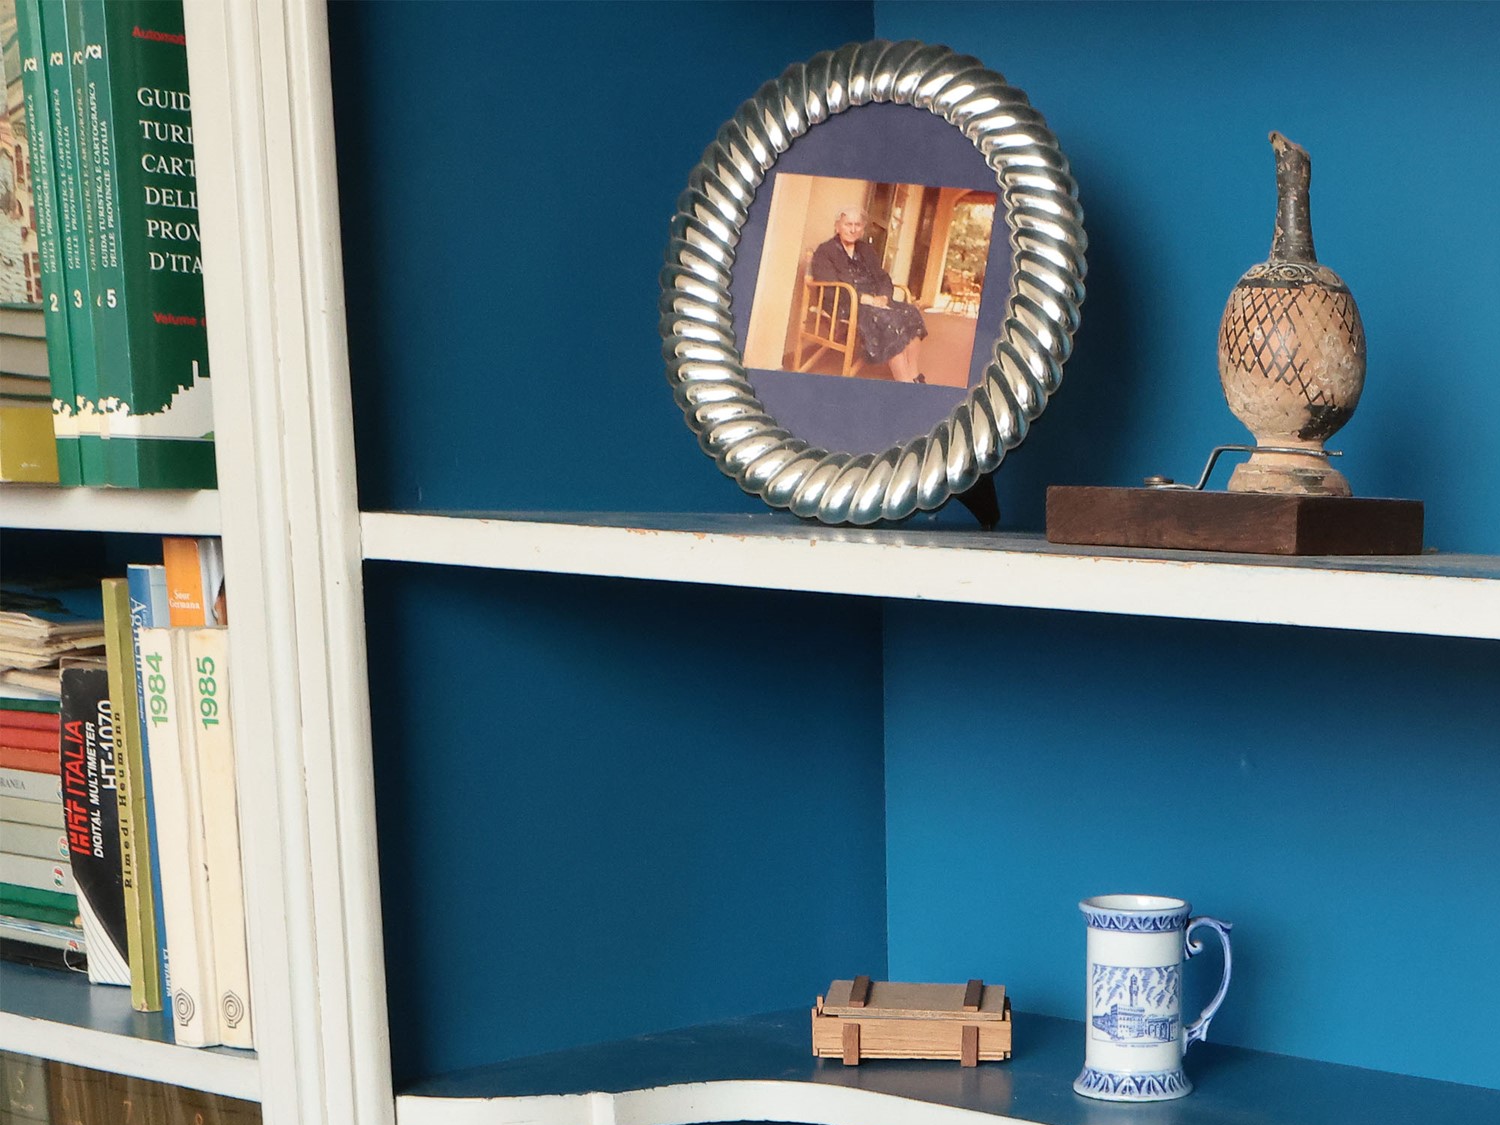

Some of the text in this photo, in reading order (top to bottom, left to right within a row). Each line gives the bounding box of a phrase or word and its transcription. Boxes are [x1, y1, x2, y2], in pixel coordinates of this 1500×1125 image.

[50, 293, 59, 312] 2
[73, 289, 82, 308] 3
[106, 288, 117, 308] 5
[146, 651, 168, 728] 1984
[196, 656, 219, 730] 1985
[64, 719, 87, 796] ITALIA
[97, 700, 117, 790] HT-1070
[85, 721, 105, 858] DIGITAL MULTIMETER
[114, 712, 132, 889] Rimedi Heumann
